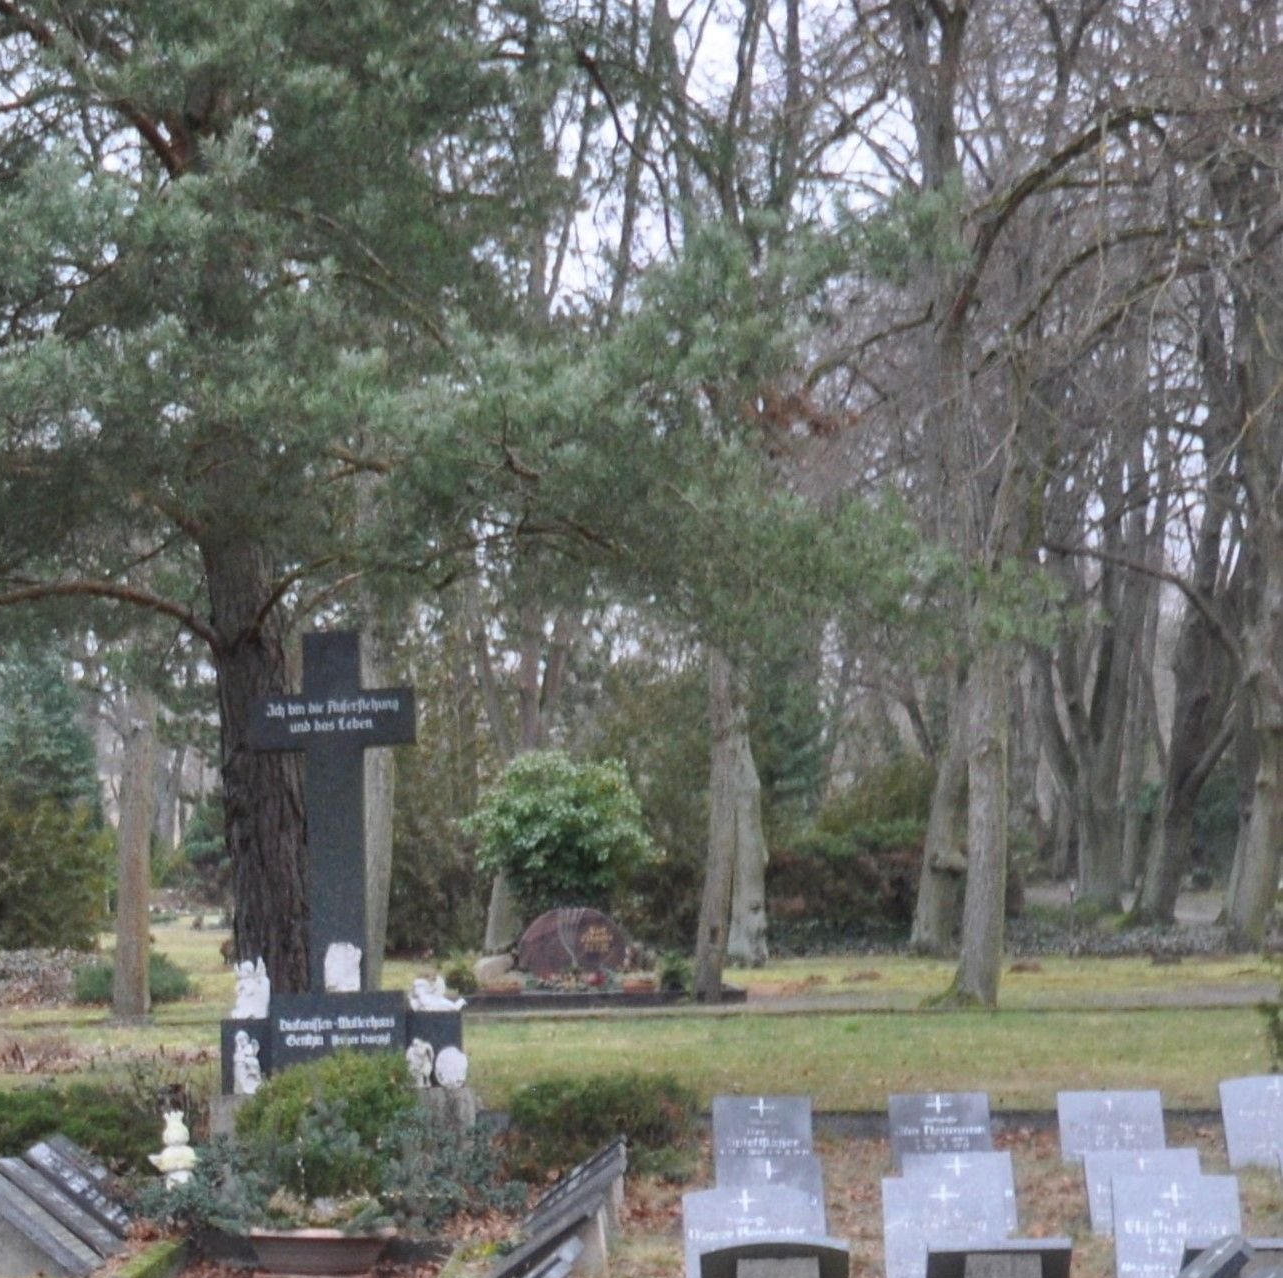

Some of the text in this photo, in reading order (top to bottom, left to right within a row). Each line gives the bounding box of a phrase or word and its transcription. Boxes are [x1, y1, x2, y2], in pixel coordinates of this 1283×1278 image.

[266, 704, 285, 719] Ich
[287, 703, 305, 715] bin
[308, 702, 323, 714] die
[289, 717, 373, 734] und das Leben
